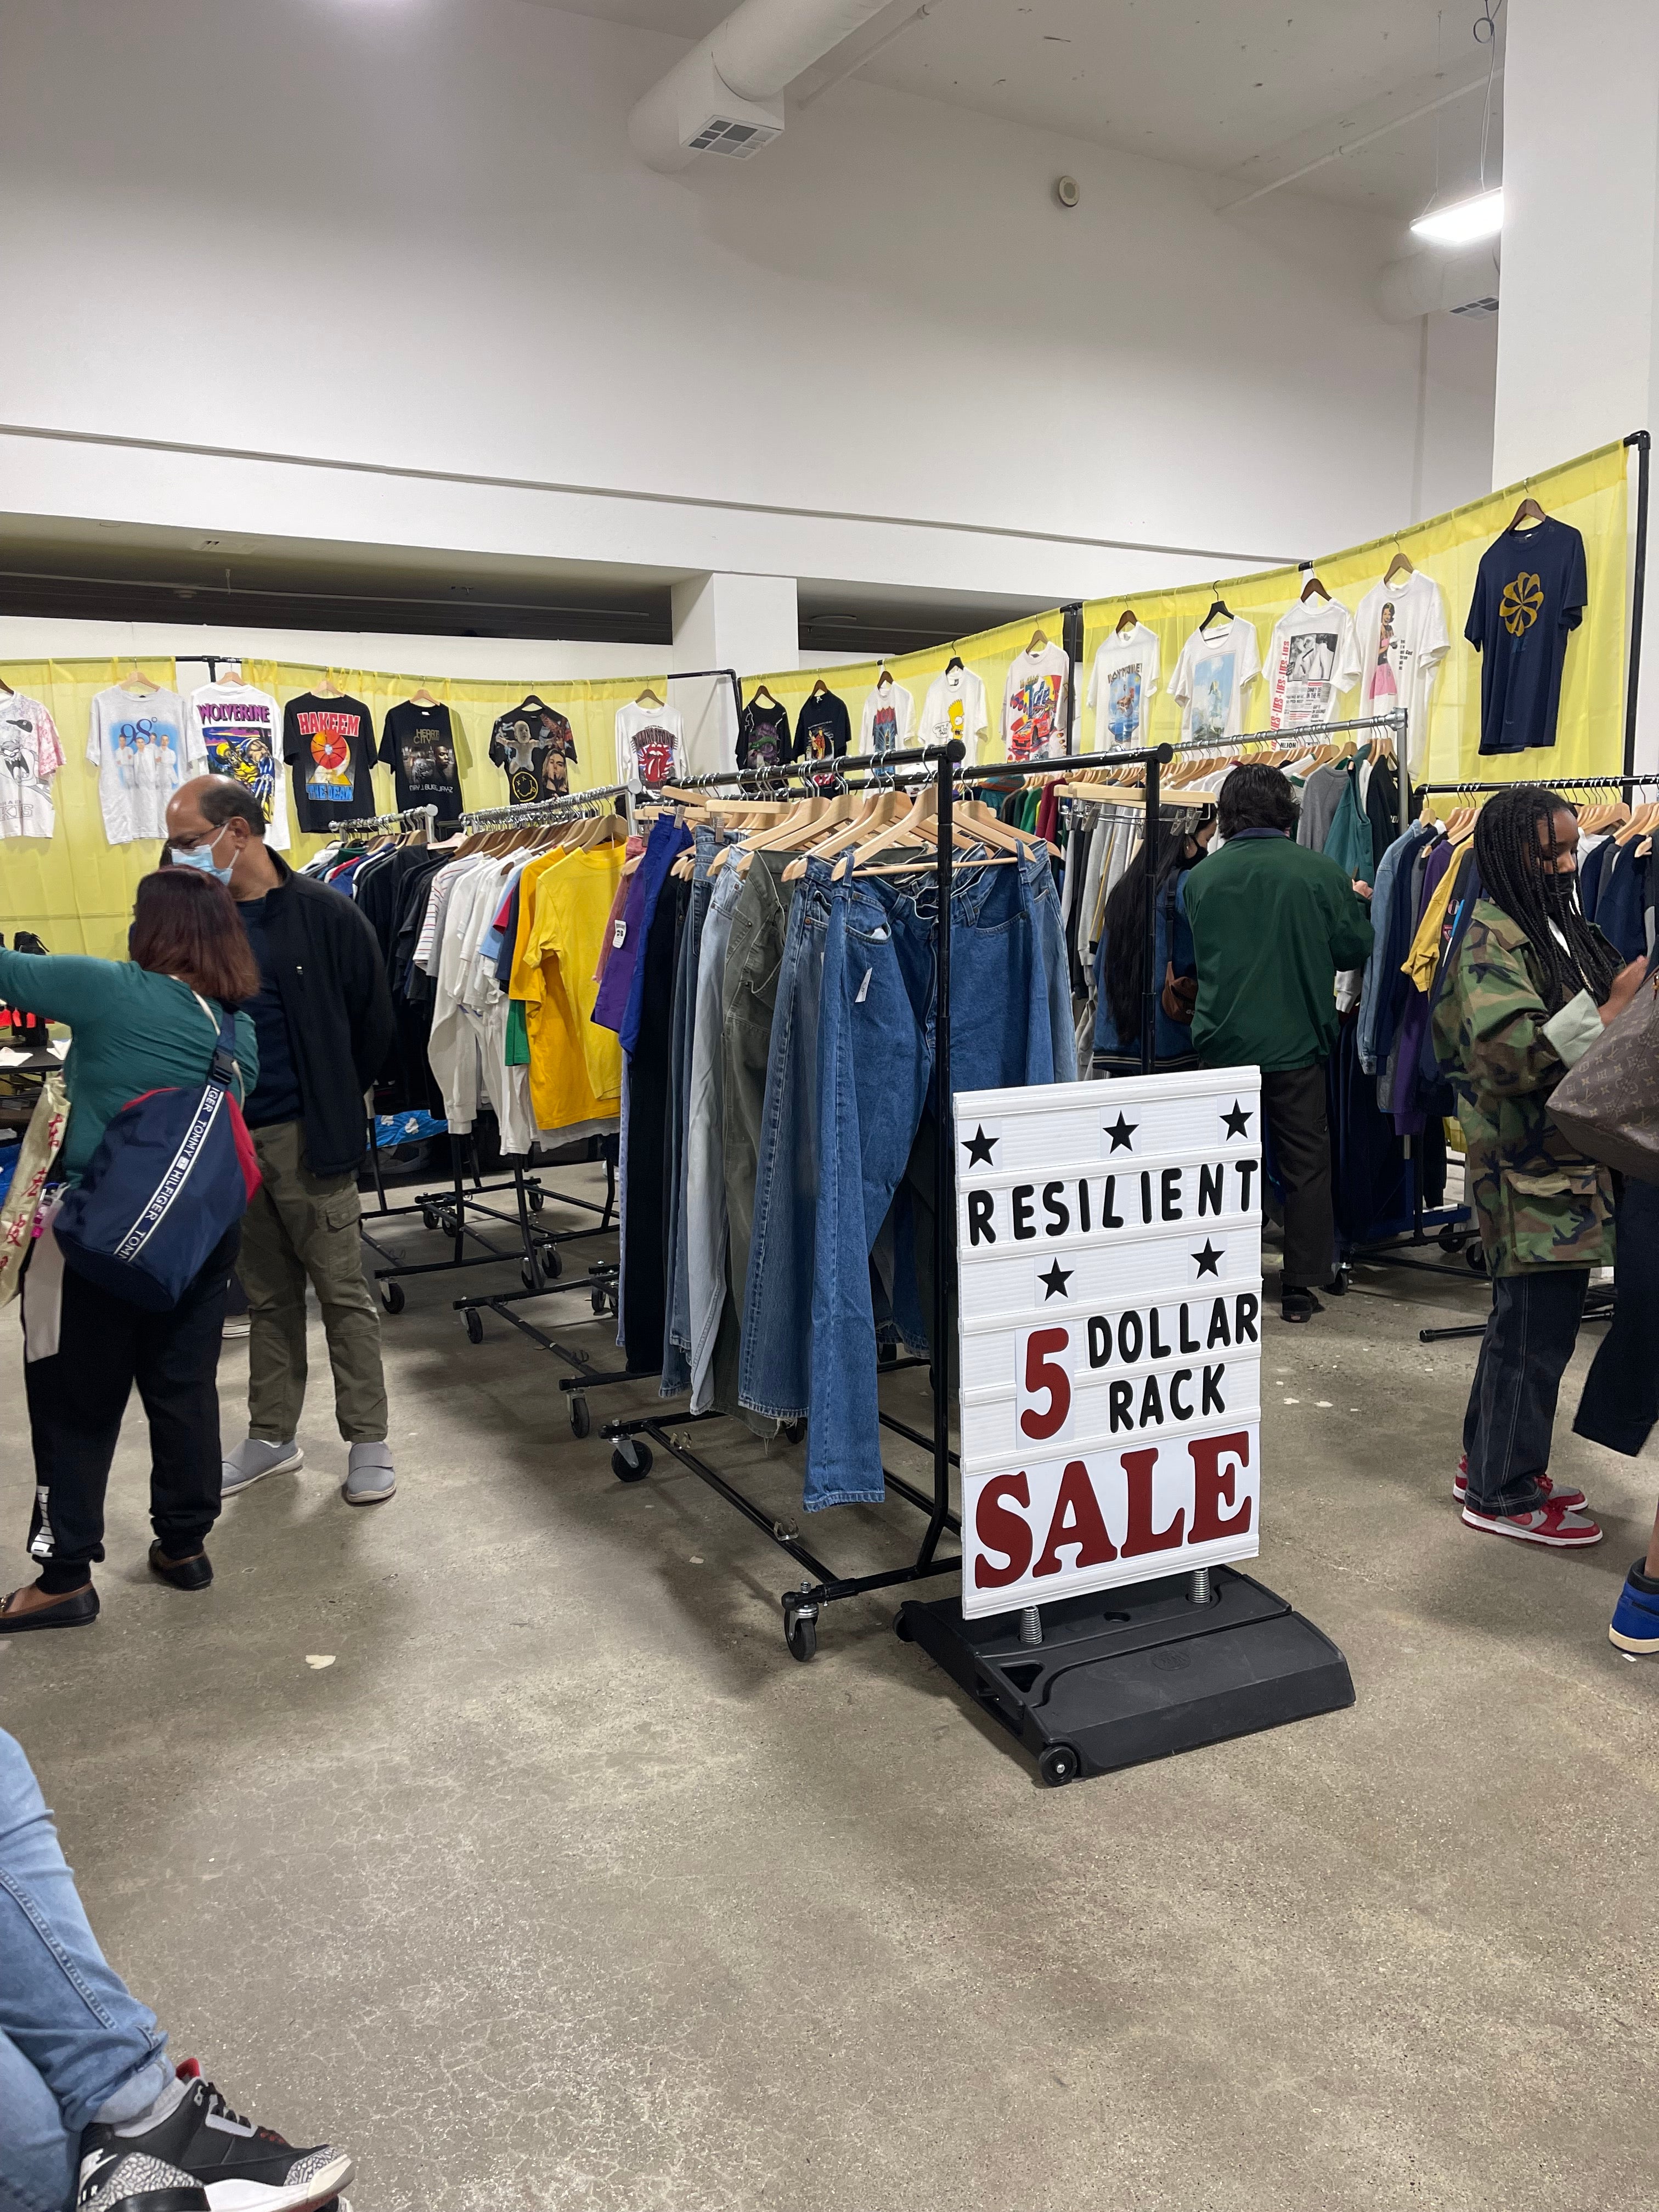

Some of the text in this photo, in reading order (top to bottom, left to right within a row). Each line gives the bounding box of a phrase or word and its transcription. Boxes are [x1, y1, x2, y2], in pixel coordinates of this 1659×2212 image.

[1276, 679, 1286, 695] LIES
[197, 703, 270, 725] WOLVERINE
[1272, 697, 1284, 714] LIES
[297, 712, 361, 737] HAKEEM
[413, 736, 431, 744] CITY
[306, 785, 327, 800] THE
[183, 1119, 207, 1158] TOMMY
[144, 1169, 184, 1221] HILFIGER
[968, 1160, 1258, 1246] RESILIENT
[1020, 1293, 1259, 1440] 5 DOLLAR
[1109, 1363, 1226, 1433] RACK
[974, 1430, 1252, 1589] SALE
